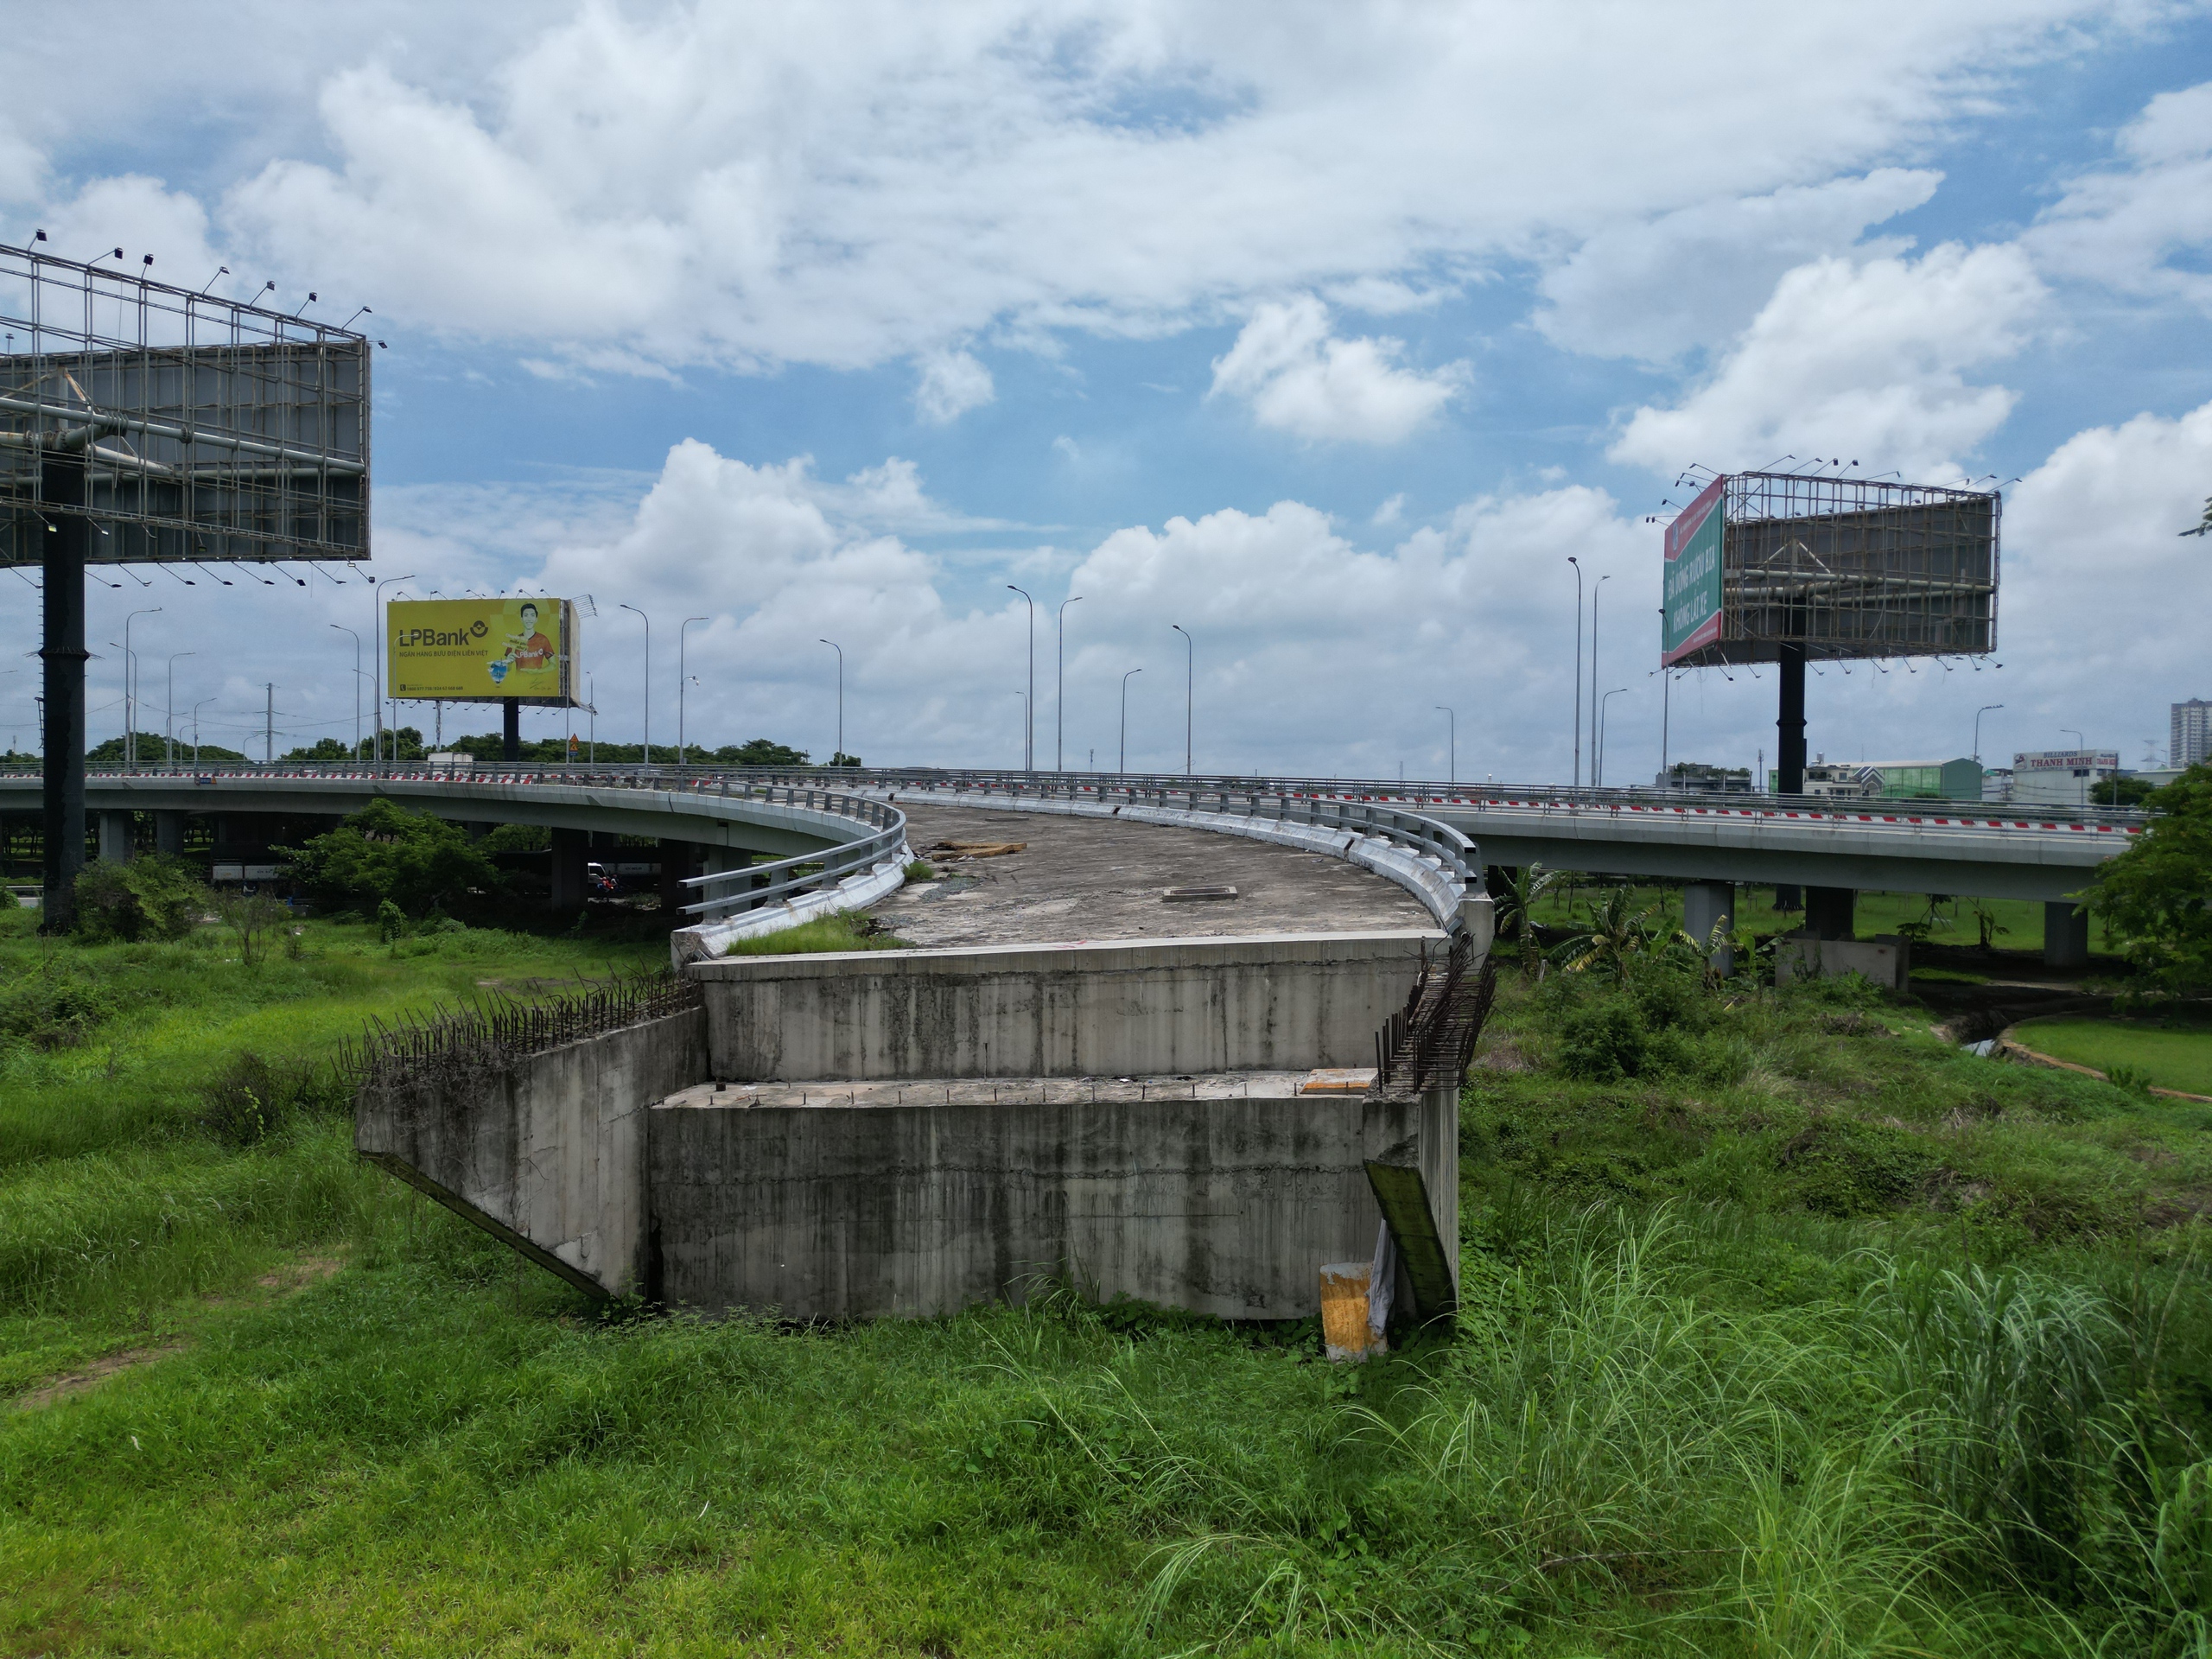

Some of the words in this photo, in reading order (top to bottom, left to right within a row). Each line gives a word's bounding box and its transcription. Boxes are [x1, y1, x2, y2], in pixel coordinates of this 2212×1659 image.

[1689, 550, 1704, 586] RƯỢU
[1706, 543, 1715, 573] BIA
[1673, 599, 1690, 633] KHÔNG
[1691, 588, 1700, 622] LÁI
[1700, 590, 1707, 618] XE
[399, 628, 469, 646] LPBank
